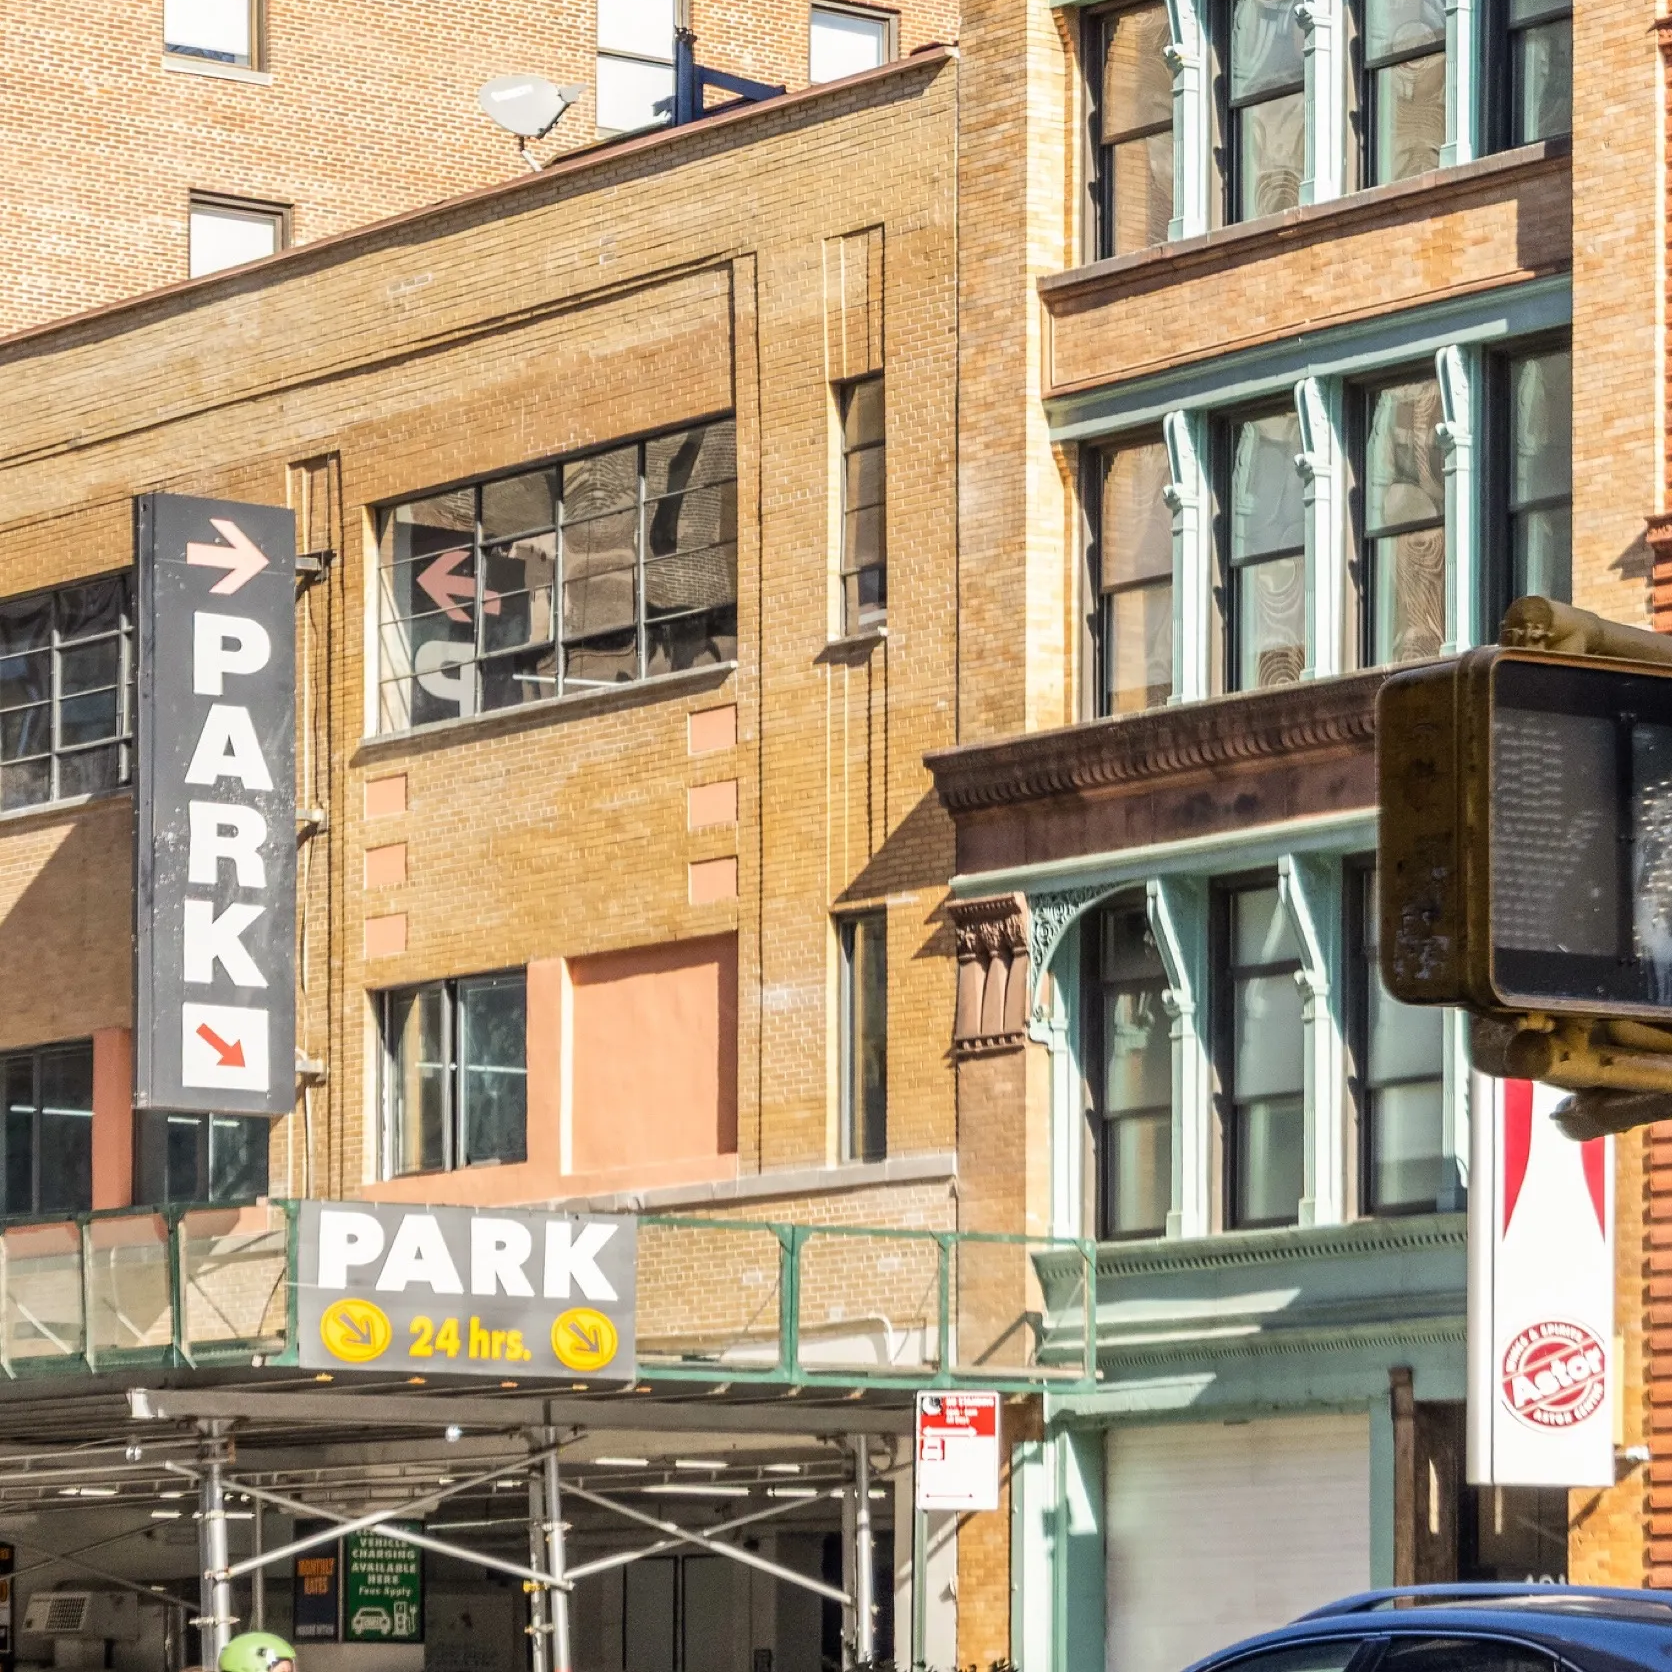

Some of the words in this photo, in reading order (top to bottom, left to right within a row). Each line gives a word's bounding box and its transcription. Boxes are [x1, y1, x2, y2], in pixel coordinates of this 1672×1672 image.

[183, 610, 274, 990] PARK
[317, 1209, 620, 1302] PARK
[408, 1315, 462, 1359] 24
[468, 1315, 532, 1362] hrs.
[1511, 1345, 1601, 1409] Astor
[351, 1562, 417, 1574] AVAILABLE
[352, 1548, 416, 1560] CHARGING
